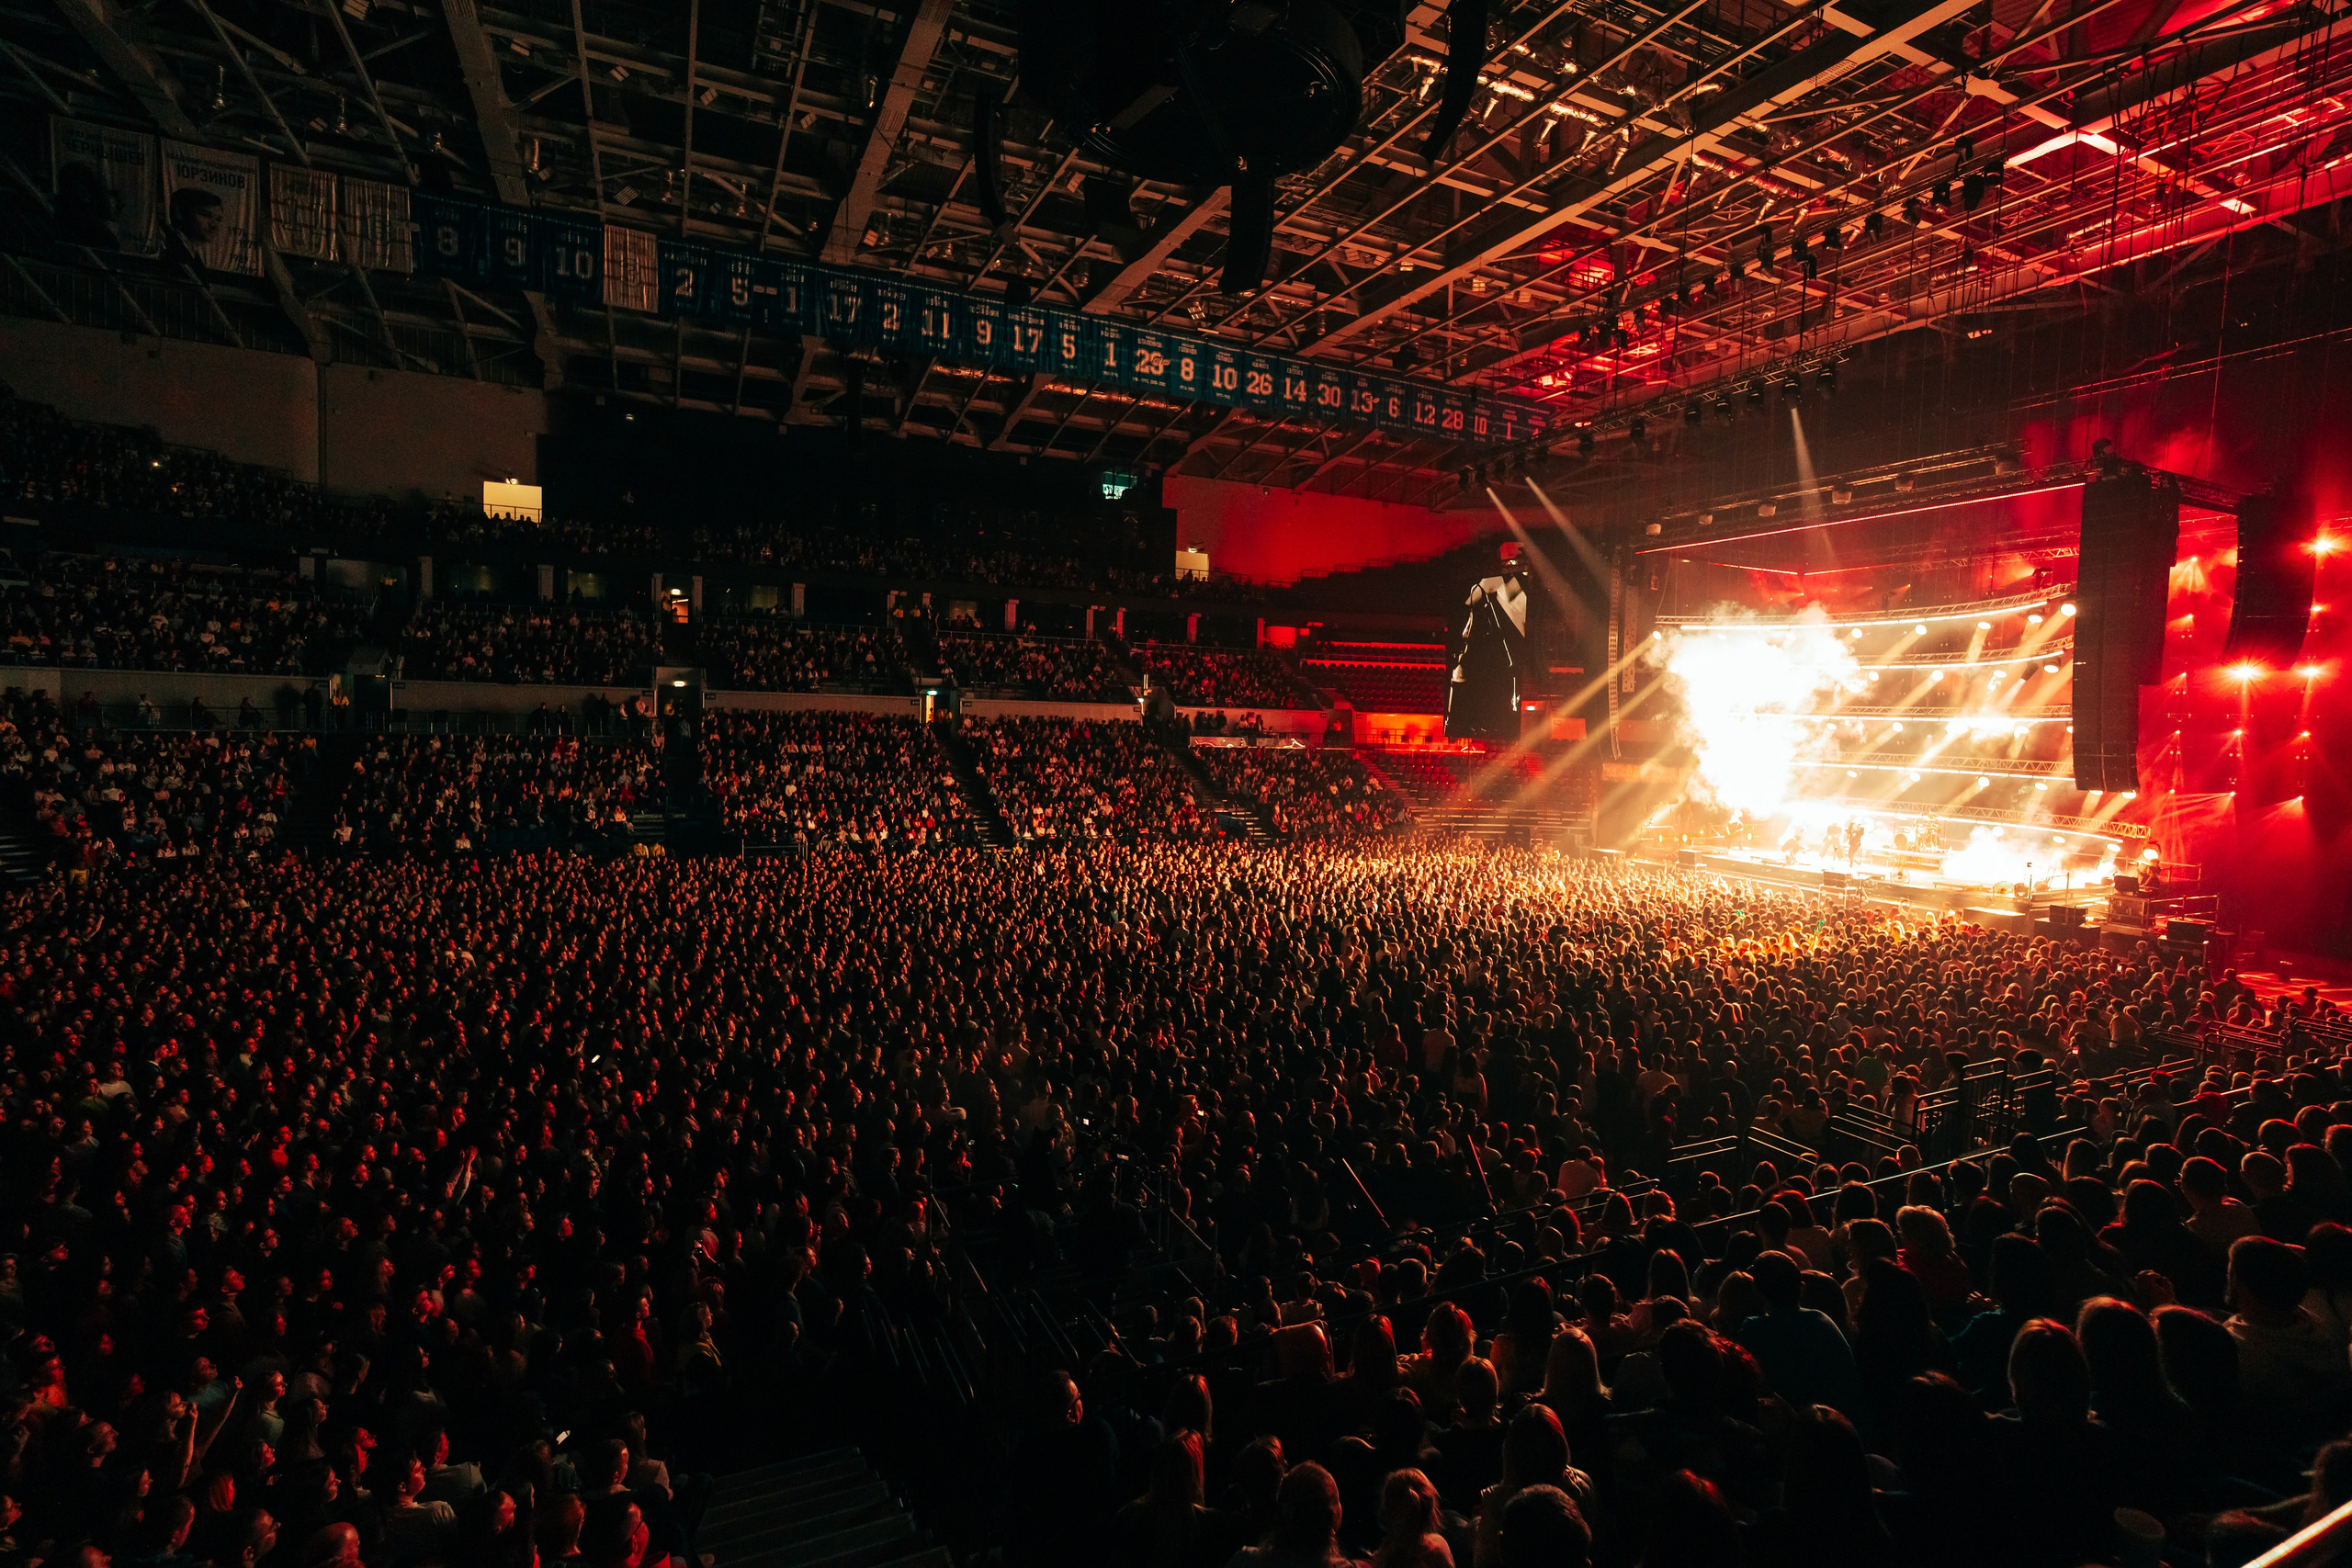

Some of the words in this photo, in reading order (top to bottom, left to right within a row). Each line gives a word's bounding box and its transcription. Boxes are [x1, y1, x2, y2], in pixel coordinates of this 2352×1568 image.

[62, 137, 144, 165] ЧЕРНЫШЕВ
[177, 164, 245, 188] ЮРЗИНОВ
[437, 226, 458, 256] 8
[504, 236, 526, 266] 9
[556, 246, 594, 279] 10
[675, 267, 694, 297] 2
[731, 277, 749, 306] 5
[786, 287, 798, 313] 1
[829, 293, 862, 323] 17
[883, 302, 899, 331] 2
[921, 310, 950, 339] 11
[976, 319, 991, 344] 9
[1013, 324, 1043, 354] 17
[1062, 333, 1076, 359] 5
[1104, 342, 1117, 367] 1
[1181, 357, 1194, 382] 8
[1212, 364, 1238, 390] 10
[1246, 370, 1273, 396] 26
[1283, 377, 1306, 402] 14
[1317, 382, 1341, 408] 30
[1351, 389, 1374, 413] 13
[1388, 397, 1400, 418] 6
[1414, 401, 1436, 425] 12
[1442, 408, 1464, 430] 28
[1474, 415, 1487, 435] 10
